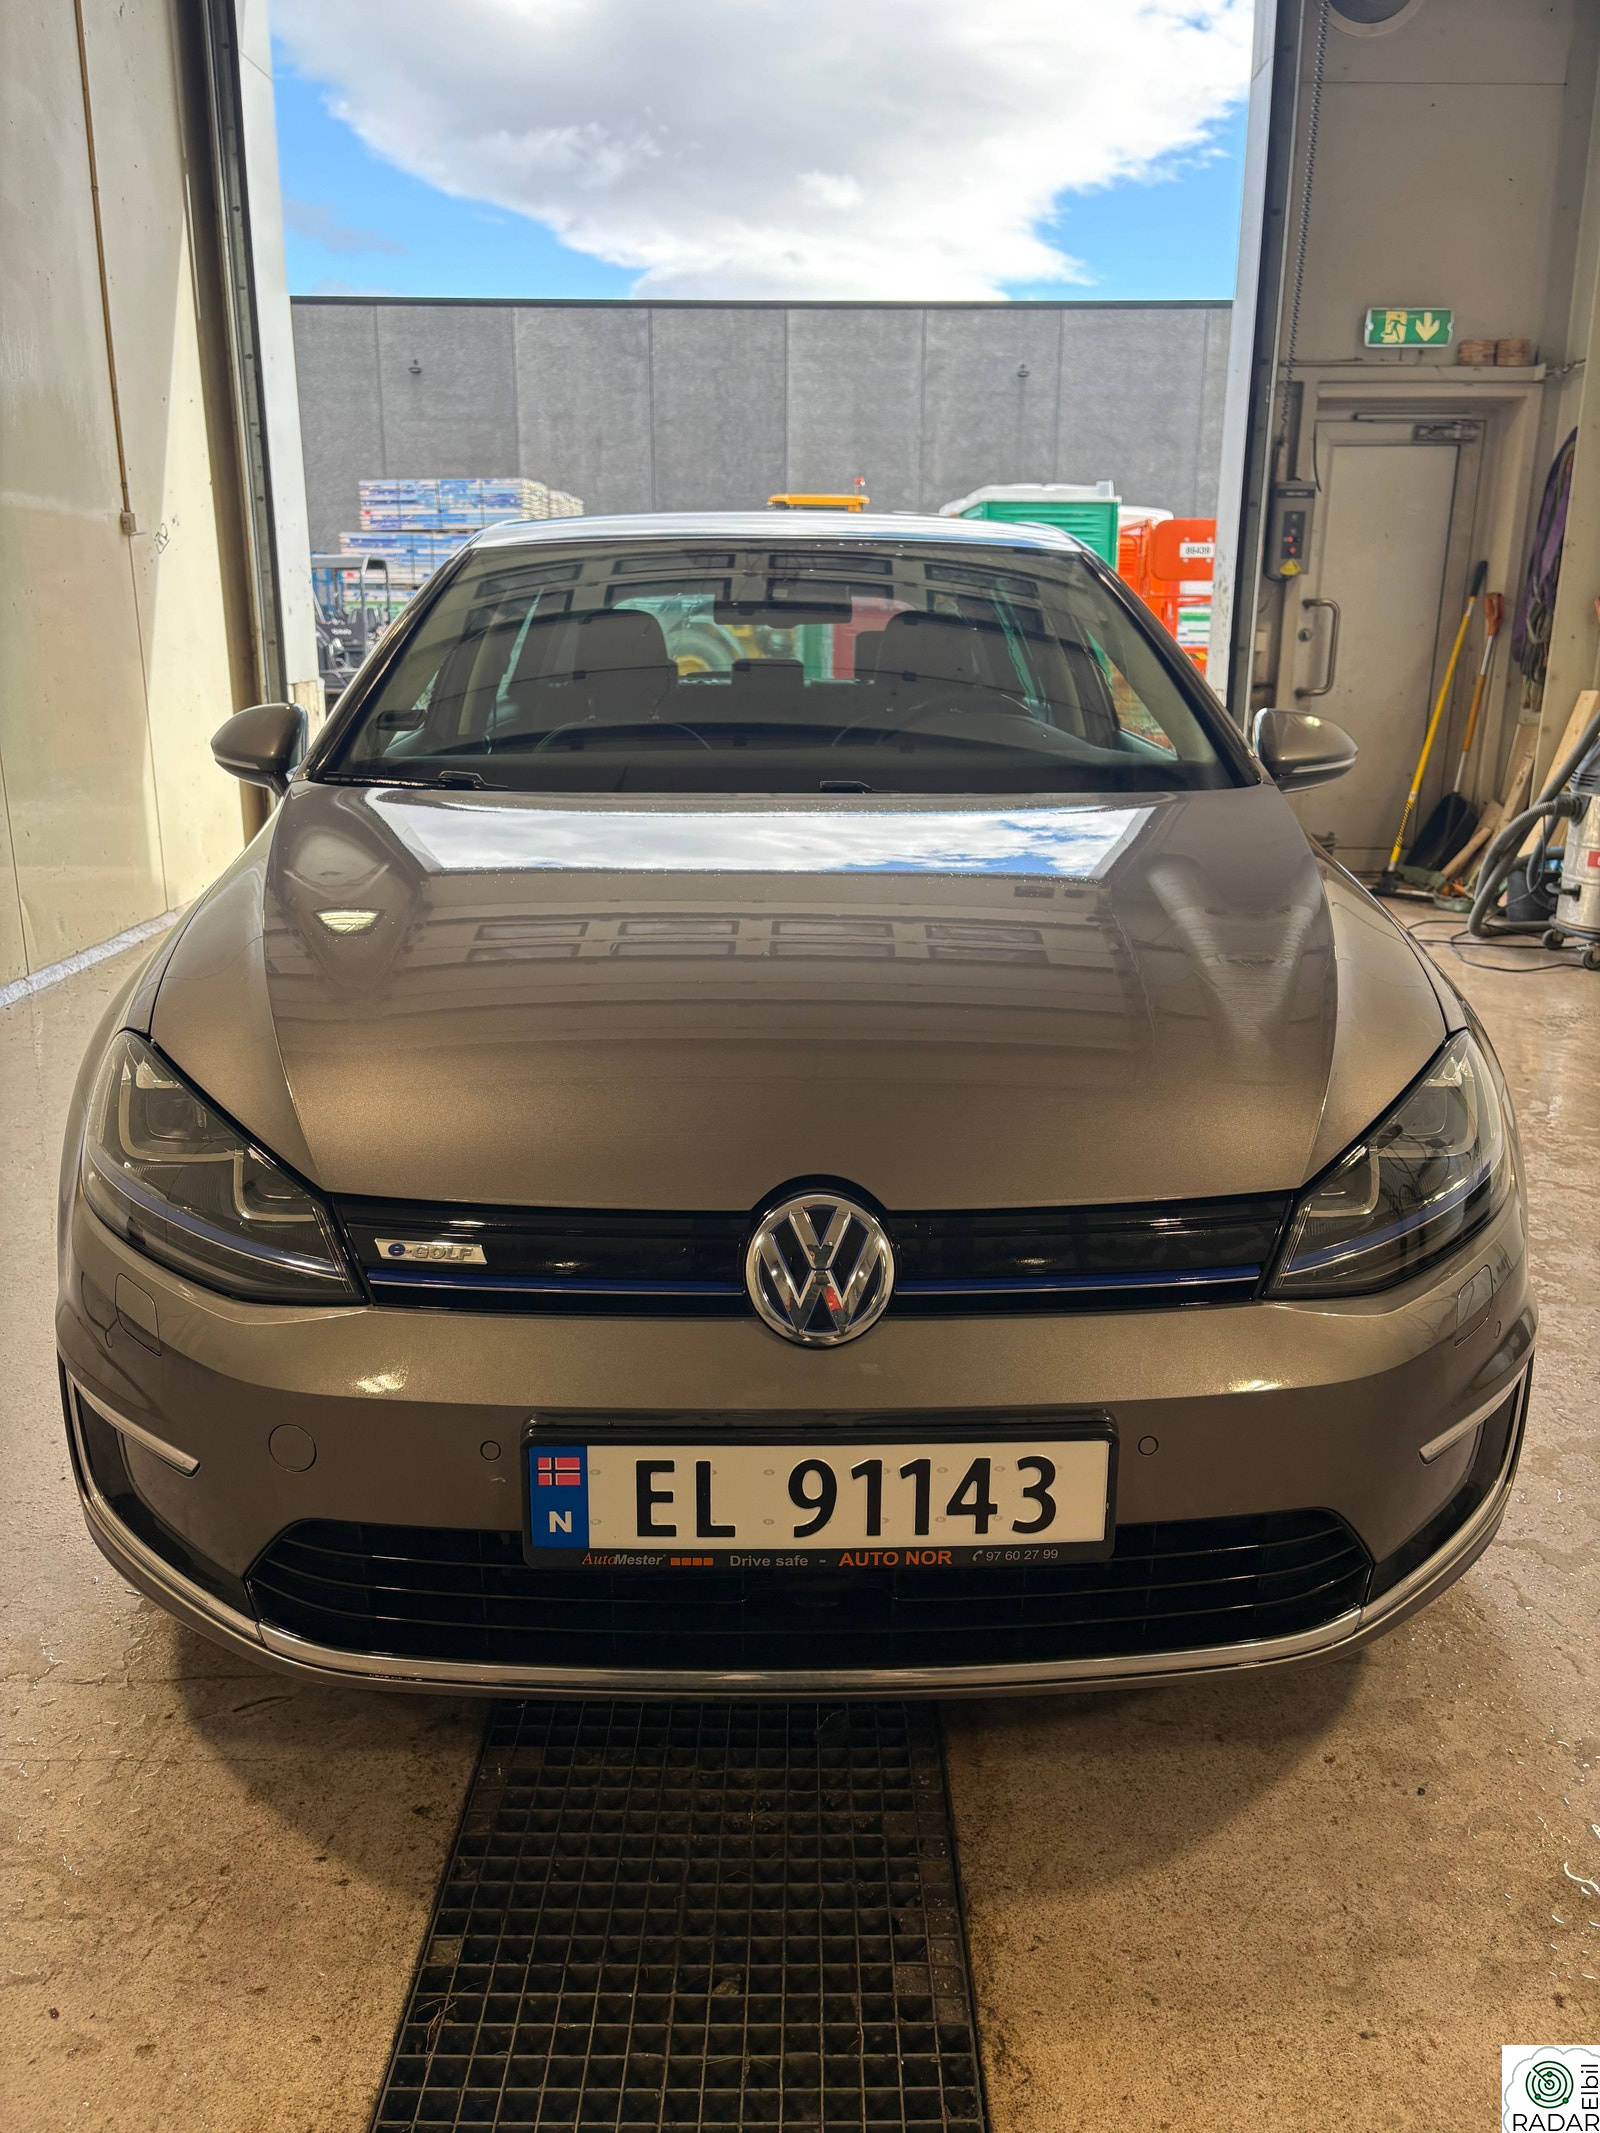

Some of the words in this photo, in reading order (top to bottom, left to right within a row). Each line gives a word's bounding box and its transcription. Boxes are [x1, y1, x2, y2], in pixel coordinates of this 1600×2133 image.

[387, 1242, 474, 1261] e-GOLF
[635, 1459, 736, 1538] EL
[787, 1455, 1057, 1538] 91143
[548, 1510, 573, 1533] N
[729, 1554, 771, 1567] Drive
[775, 1554, 809, 1567] safe
[838, 1551, 899, 1567] AUTO
[905, 1550, 953, 1566] NOR
[985, 1551, 1001, 1562] 97
[1004, 1551, 1021, 1561] 60
[1023, 1550, 1040, 1560] 27
[1042, 1549, 1059, 1559] 99
